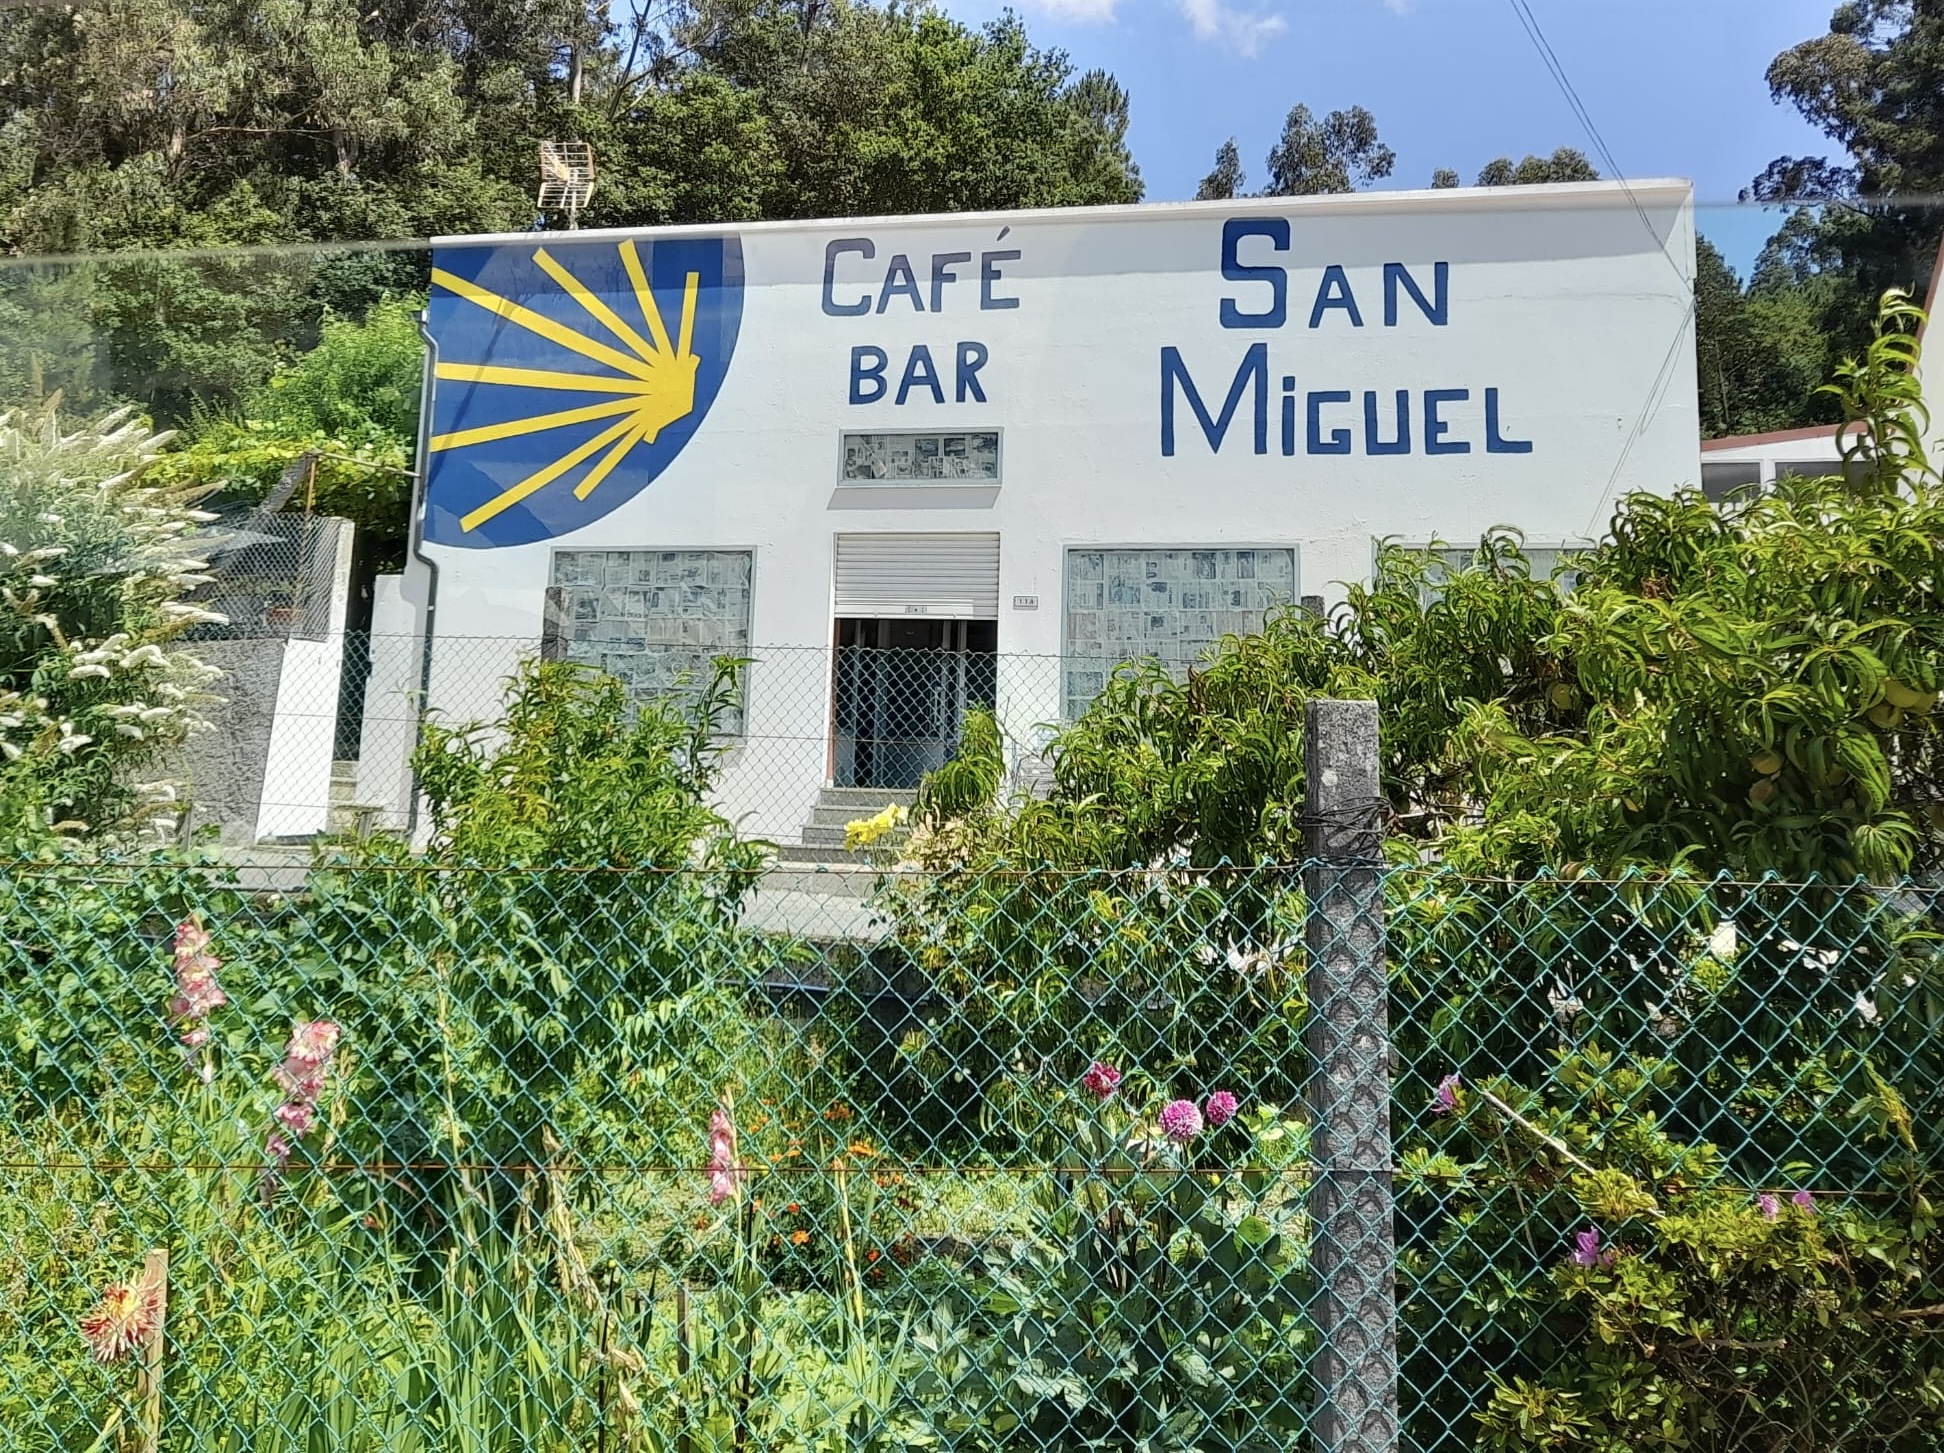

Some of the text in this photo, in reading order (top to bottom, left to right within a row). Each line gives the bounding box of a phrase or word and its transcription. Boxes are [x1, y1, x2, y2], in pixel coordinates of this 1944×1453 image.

[822, 226, 1021, 316] CAFÉ
[1220, 217, 1448, 328] SAN
[849, 341, 988, 405] BAR
